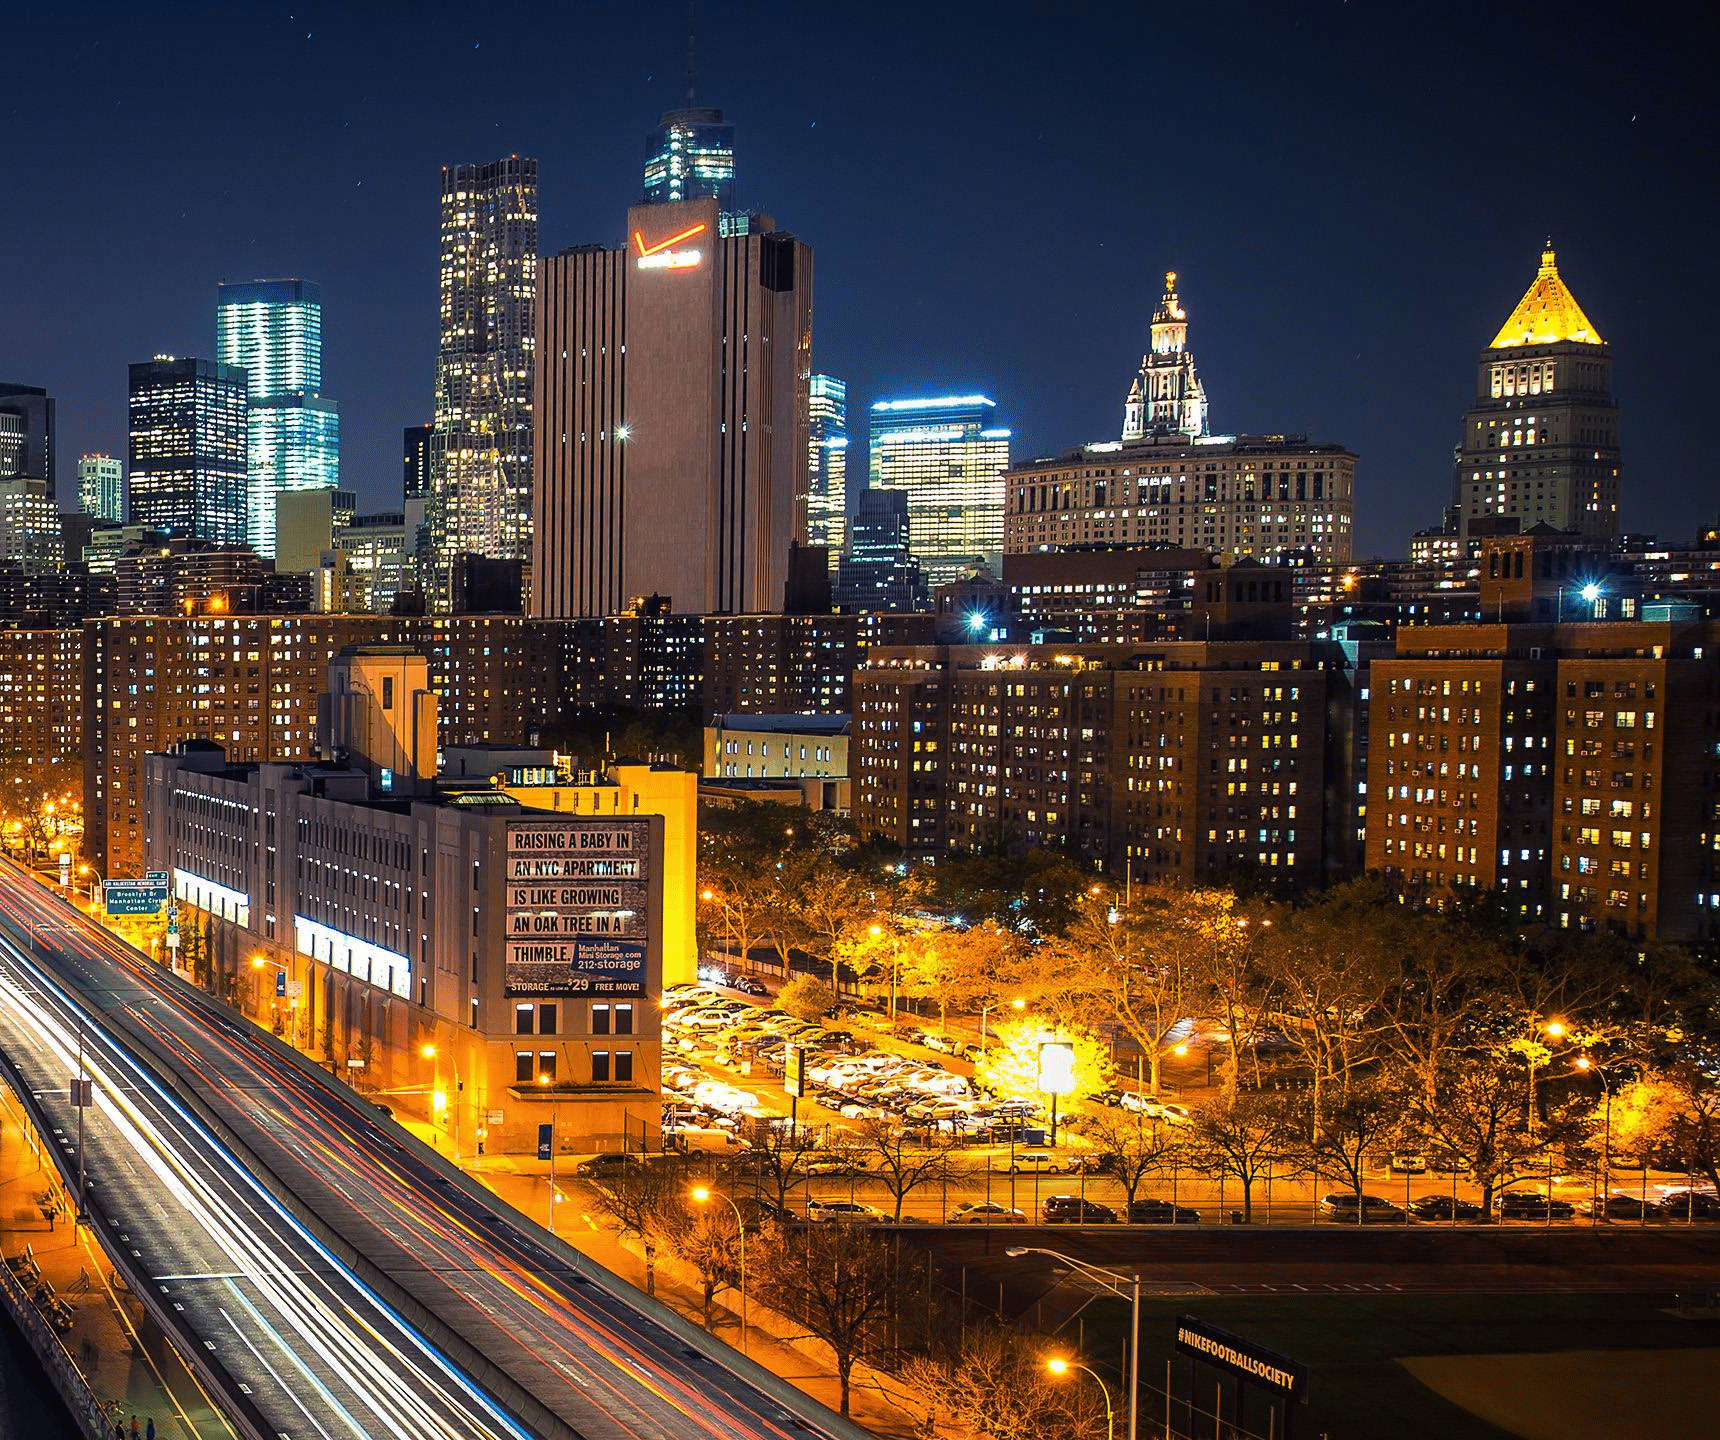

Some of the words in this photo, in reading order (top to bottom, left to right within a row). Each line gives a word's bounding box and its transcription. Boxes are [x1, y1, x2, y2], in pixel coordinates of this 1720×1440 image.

[515, 833, 565, 849] RAISING
[568, 833, 577, 849] A
[580, 833, 613, 849] BABY
[616, 833, 630, 849] IN
[514, 861, 530, 876] AN
[535, 861, 560, 876] NYC
[562, 861, 637, 876] APARTMENT
[514, 889, 527, 905] IS
[530, 889, 557, 905] LIKE
[561, 889, 619, 905] GROWING
[513, 917, 530, 932] AN
[534, 917, 559, 932] OAK
[562, 917, 593, 932] TREE
[596, 917, 610, 932] IN
[613, 917, 622, 932] A
[513, 946, 571, 962] THIMBLE.
[578, 943, 619, 952] Manhattan
[511, 982, 549, 991] STORAGE
[595, 983, 614, 991] FREE
[615, 983, 640, 991] MOVE!
[1178, 1327, 1295, 1390] #NIKEFOOTBALLSOCIETY
